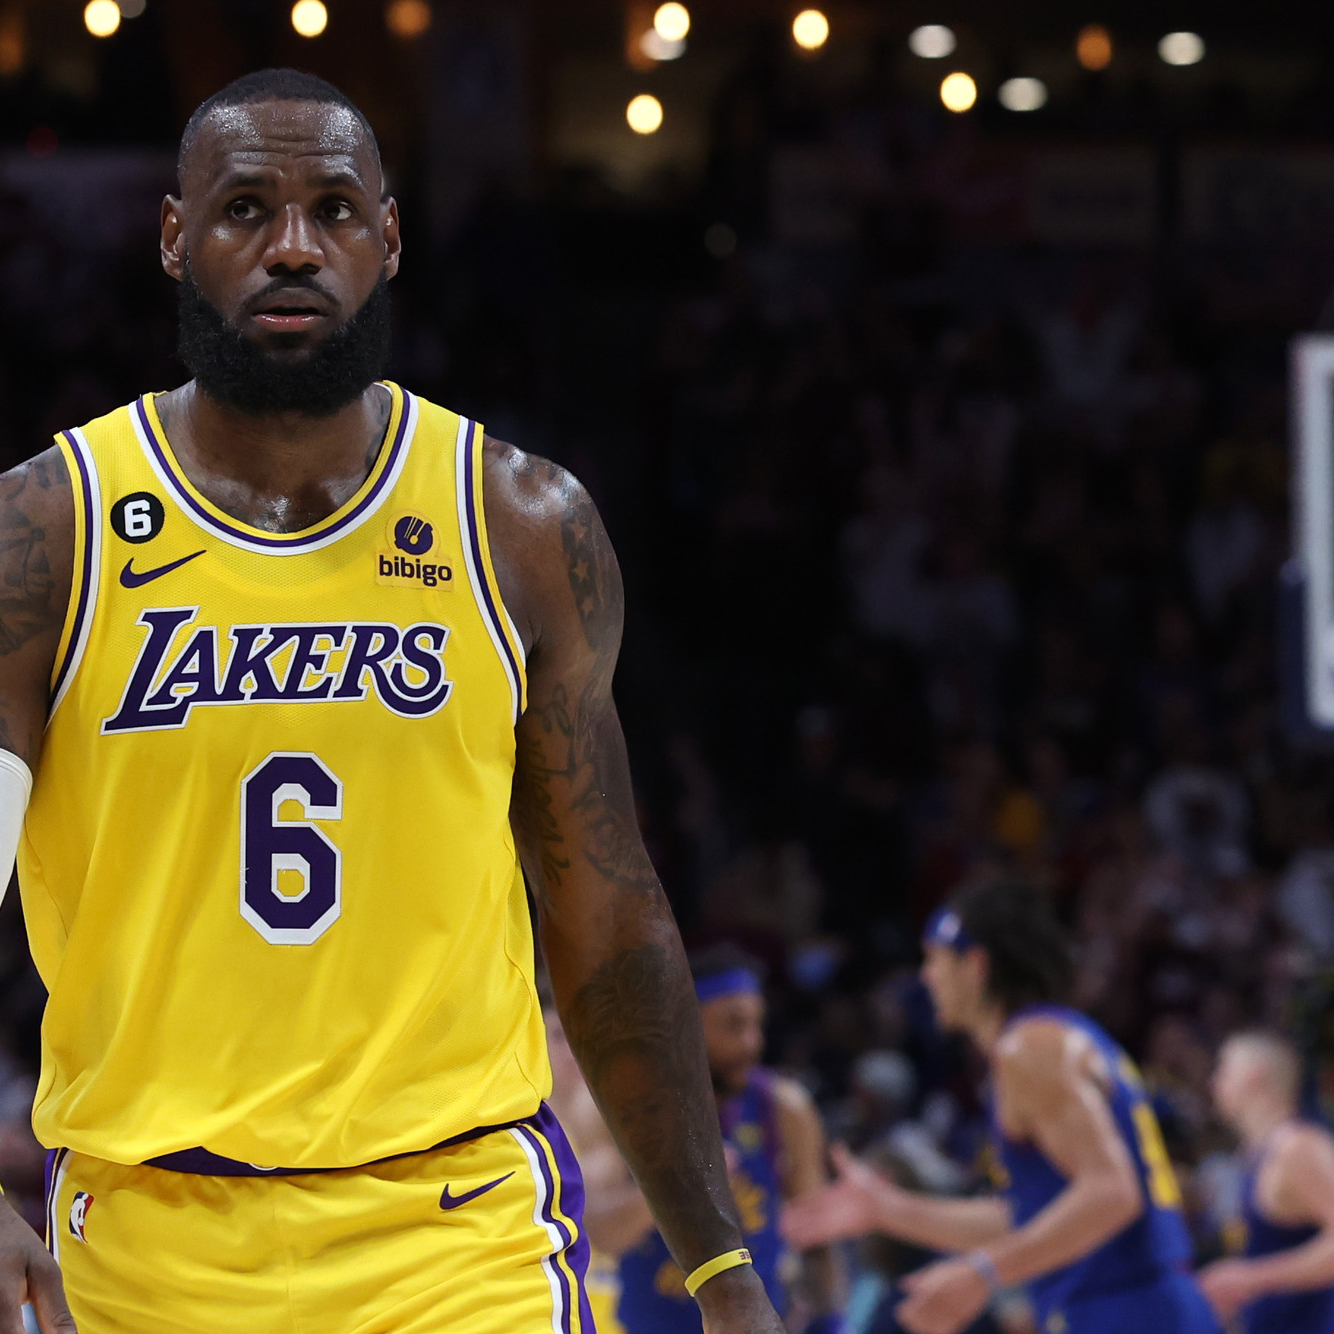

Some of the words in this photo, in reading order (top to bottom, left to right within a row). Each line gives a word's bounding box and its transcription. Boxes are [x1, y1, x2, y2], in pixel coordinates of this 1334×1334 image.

[123, 499, 152, 538] 6
[378, 555, 453, 587] bibigo
[100, 605, 454, 736] LAKERS
[239, 750, 343, 945] 6
